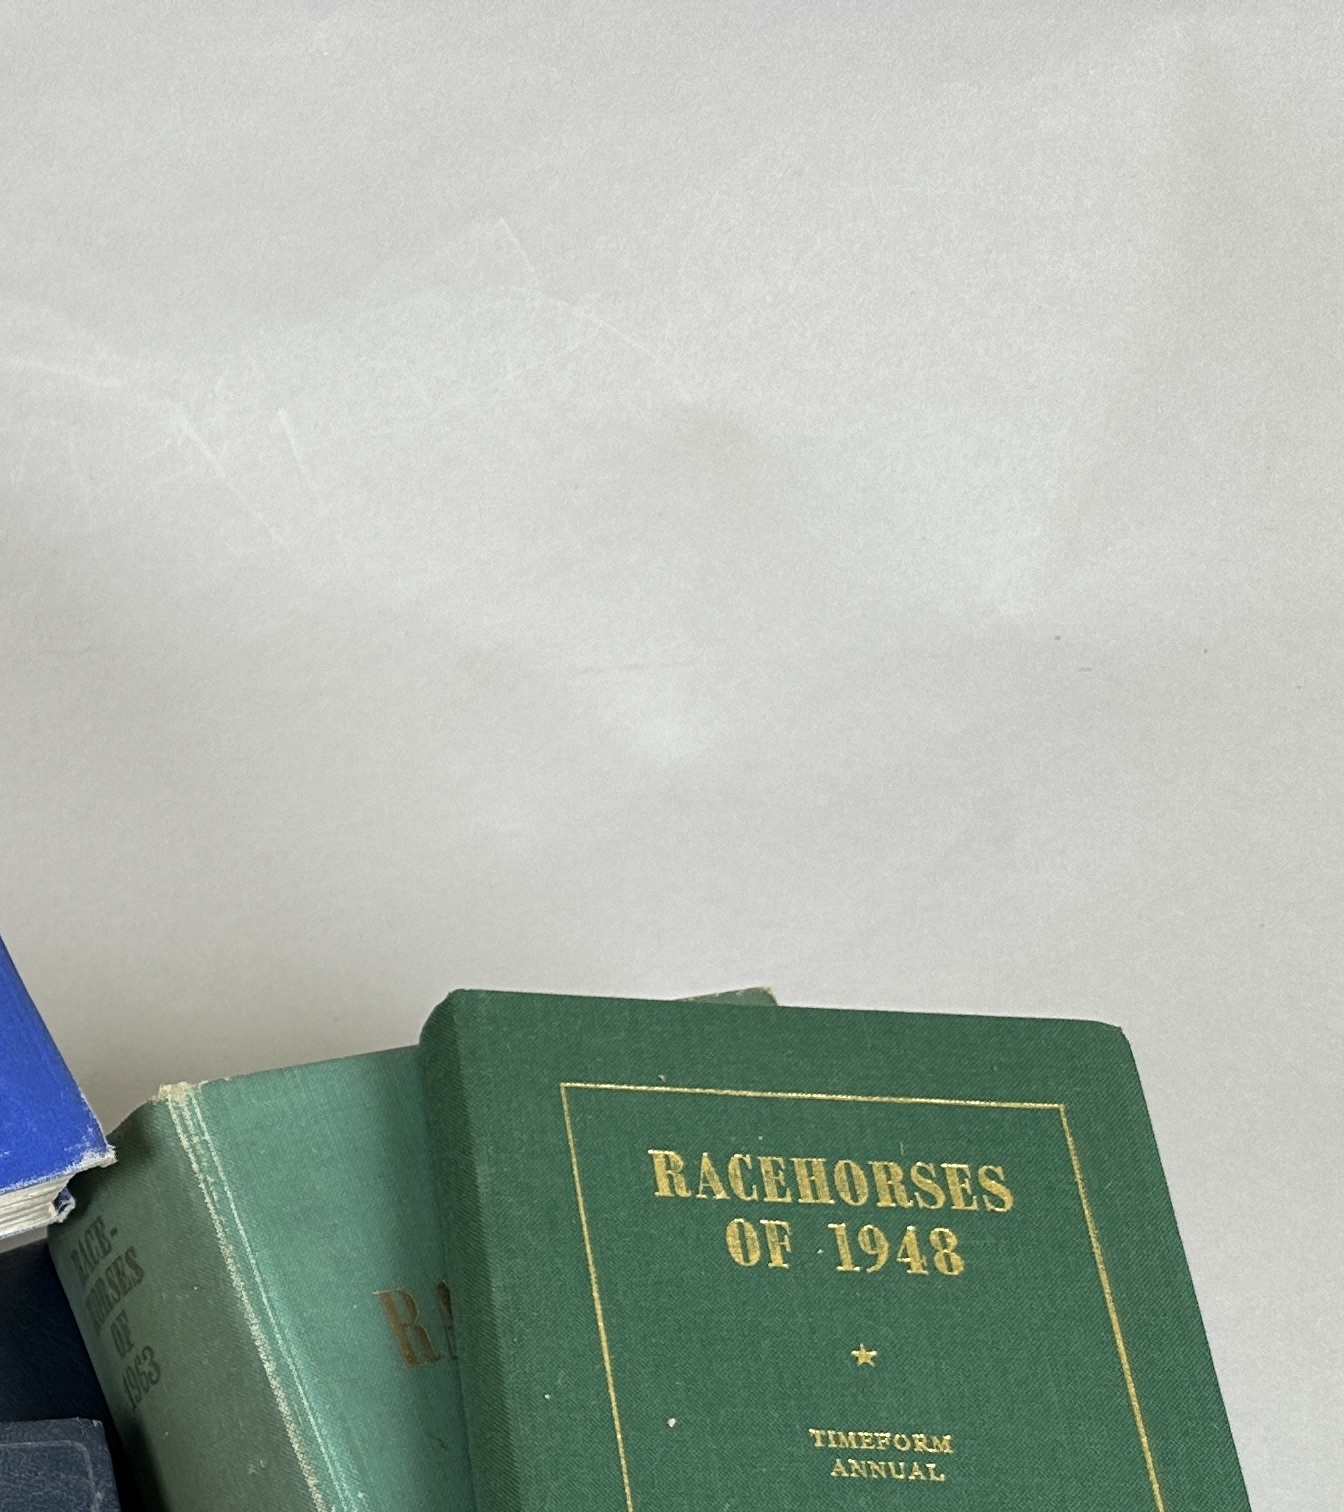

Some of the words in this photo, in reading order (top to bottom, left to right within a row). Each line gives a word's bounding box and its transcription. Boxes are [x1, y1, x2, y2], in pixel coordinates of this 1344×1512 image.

[647, 1148, 1015, 1213] RACEHORSES
[725, 1217, 793, 1270] OF
[827, 1222, 966, 1277] 1948
[122, 1345, 162, 1412] 1963
[808, 1427, 954, 1454] TIMEFORM
[830, 1456, 946, 1482] ANNUAL
